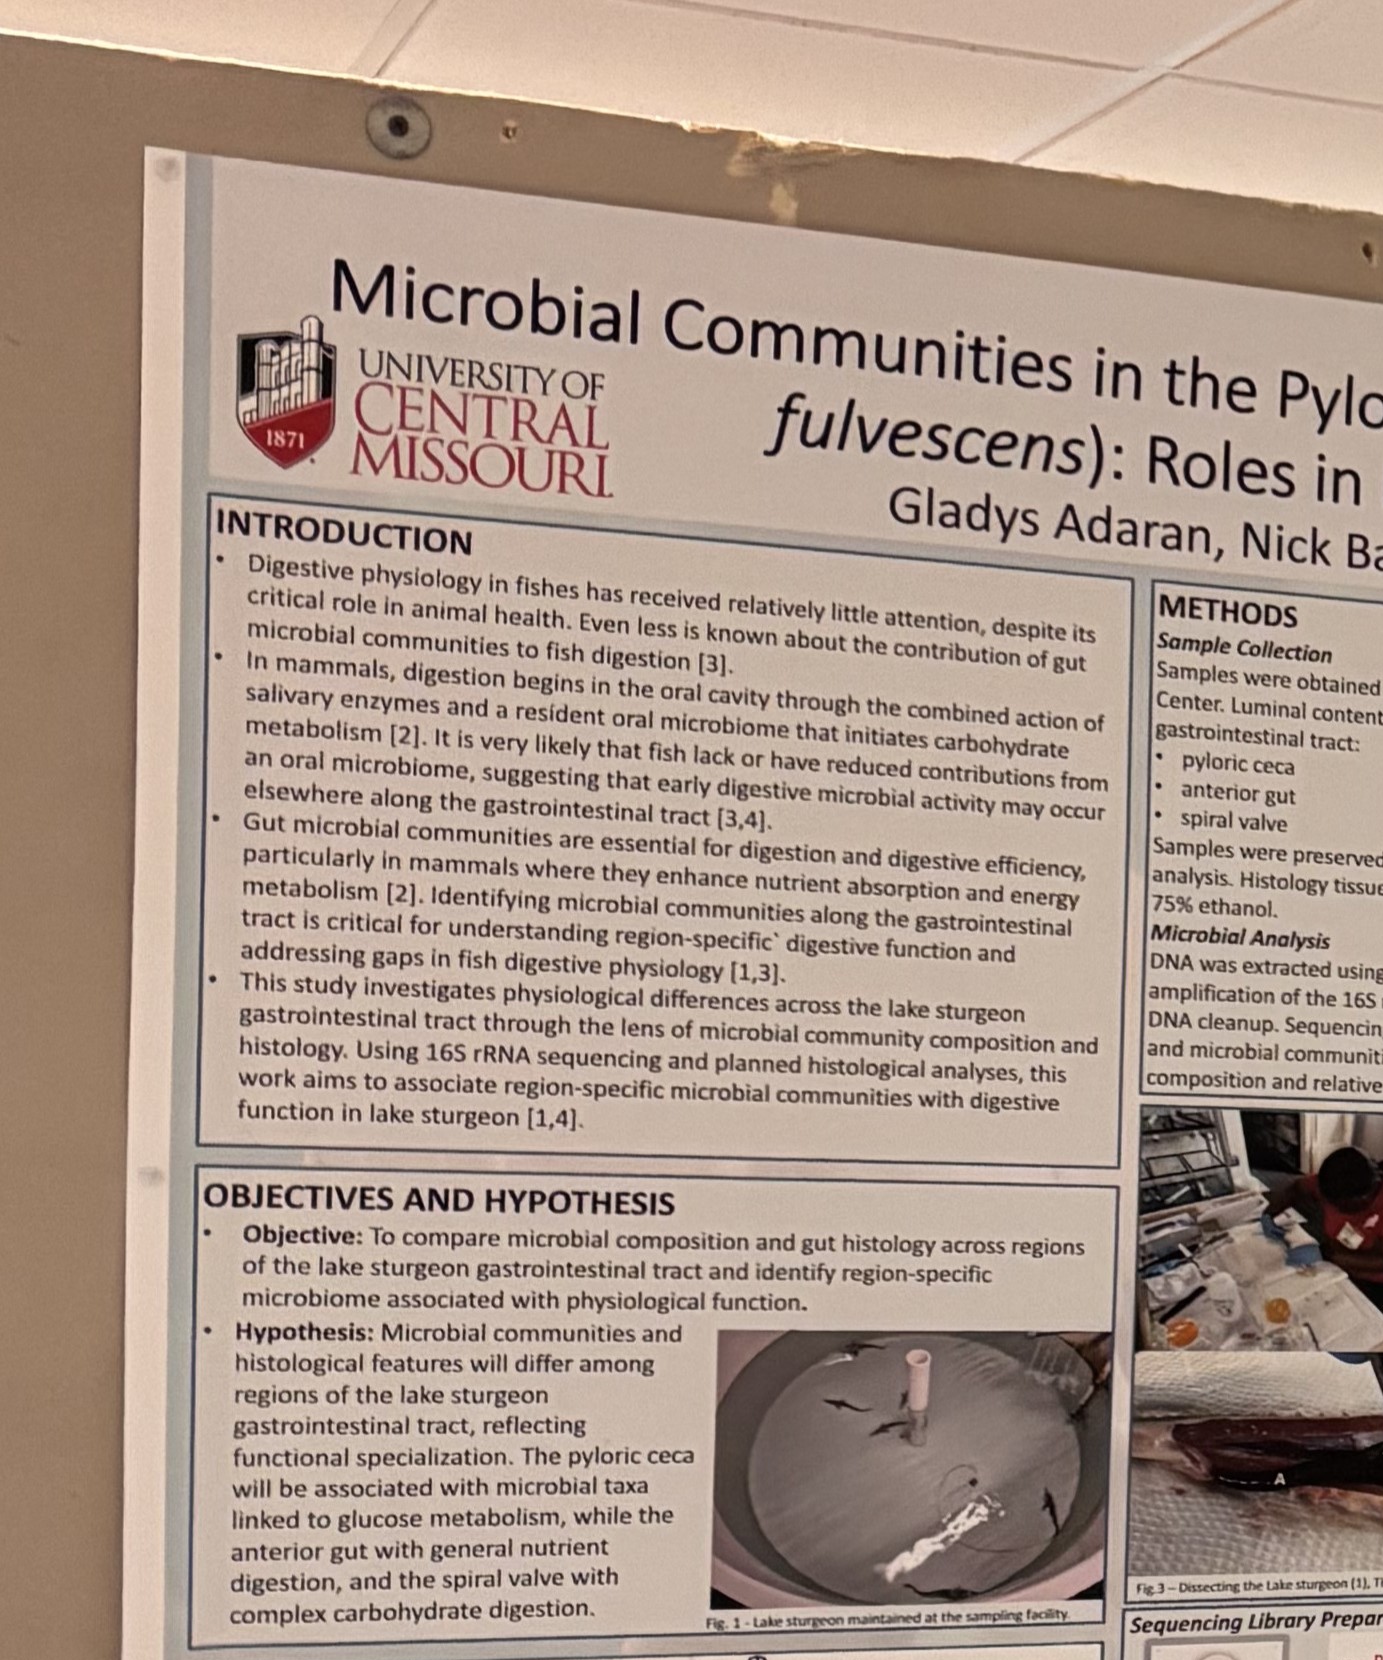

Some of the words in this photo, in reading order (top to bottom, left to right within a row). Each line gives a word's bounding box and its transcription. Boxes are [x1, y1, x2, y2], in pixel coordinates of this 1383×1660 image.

[333, 258, 640, 345] Microbial
[664, 298, 1073, 393] Communities
[1095, 346, 1142, 401] in
[1163, 355, 1257, 414] the
[359, 348, 557, 395] UNIVERSITY
[561, 370, 605, 400] OF
[354, 381, 610, 450] CENTRAL
[265, 428, 305, 450] 1871
[762, 391, 1124, 490] fulvescens):
[1148, 434, 1296, 499] Roles
[1316, 453, 1361, 507] in
[349, 431, 613, 498] MISSOURI
[217, 508, 473, 556] INTRODUCTION
[889, 486, 1040, 544] Gladys
[1053, 503, 1225, 563] Adaran,
[1242, 521, 1332, 567] Nick
[248, 553, 355, 581] Digestive
[361, 562, 483, 596] physiology
[489, 573, 509, 594] in
[515, 575, 580, 600] fishes
[586, 580, 624, 604] has
[630, 588, 721, 612] received
[728, 594, 826, 625] relatively
[831, 601, 879, 625] little
[884, 610, 986, 637] attention,
[991, 616, 1067, 643] despite
[1072, 626, 1097, 644] its
[1159, 593, 1298, 629] METHODS
[1156, 632, 1233, 657] Sample
[1236, 639, 1333, 664] Collection
[1182, 751, 1249, 773] pyloric
[1252, 759, 1295, 776] ceca
[1181, 783, 1261, 803] anterior
[1264, 789, 1297, 808] gut
[1180, 810, 1234, 831] spiral
[1238, 812, 1288, 833] valve
[1150, 923, 1247, 946] Microbial
[1248, 929, 1331, 953] Analysis
[203, 1182, 394, 1211] OBJECTIVES
[402, 1187, 475, 1213] AND
[485, 1188, 676, 1216] HYPOTHESIS
[229, 1603, 327, 1629] complex
[333, 1600, 483, 1625] carbohydrate
[488, 1599, 595, 1623] digestion.
[1129, 1614, 1244, 1637] Sequencing
[1247, 1611, 1317, 1632] Library
